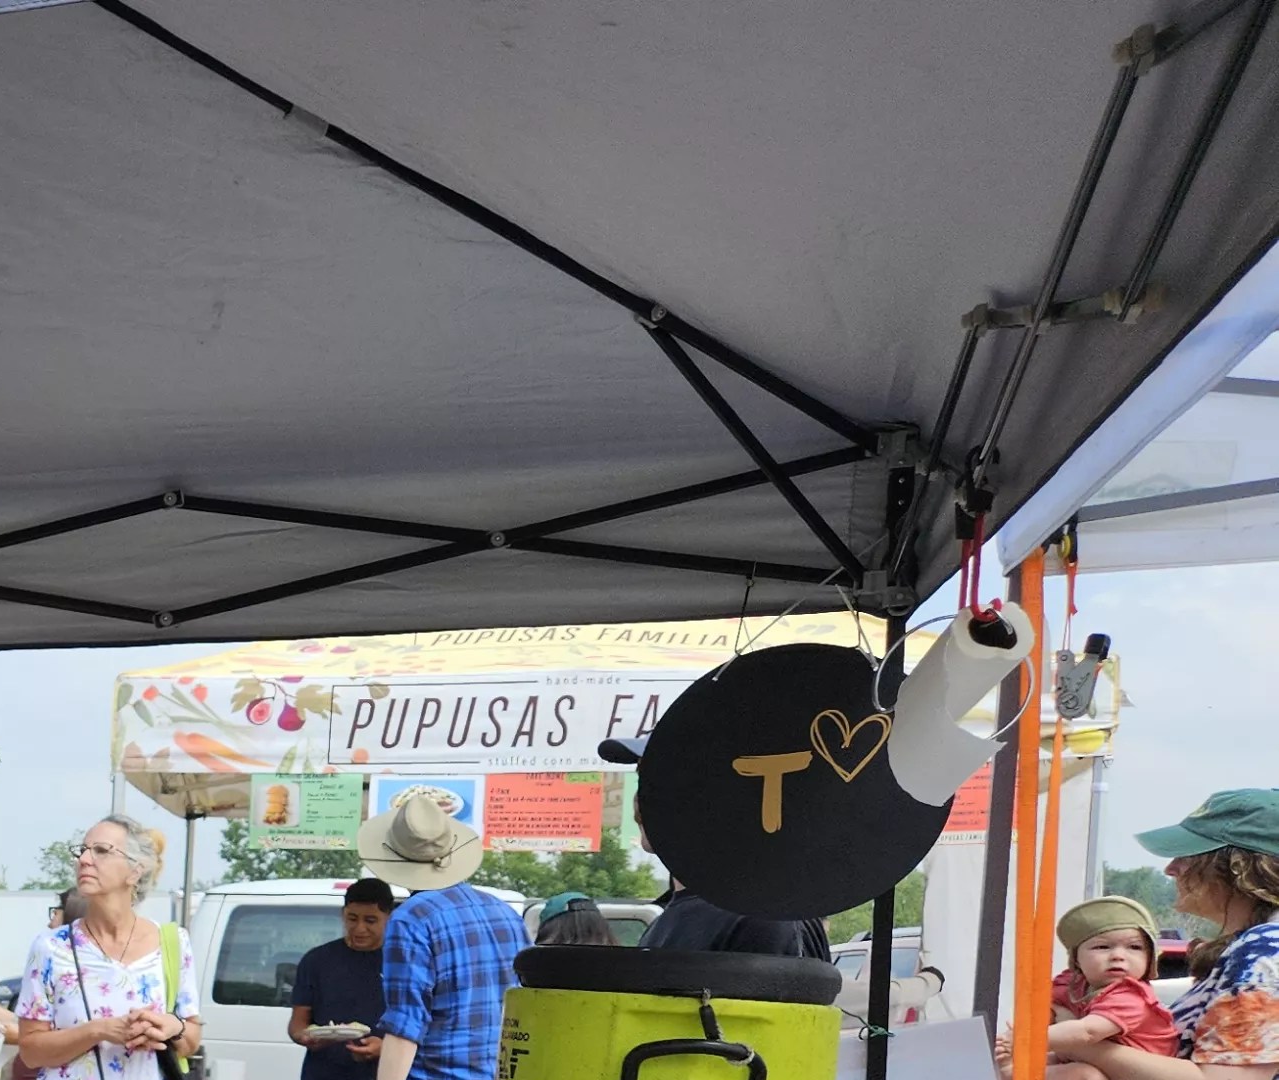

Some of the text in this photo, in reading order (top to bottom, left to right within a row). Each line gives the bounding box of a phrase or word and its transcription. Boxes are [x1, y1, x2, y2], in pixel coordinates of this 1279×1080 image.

[430, 626, 729, 647] PUPUSAS FAMILIA
[545, 674, 623, 686] hand-made
[346, 694, 576, 750] PUPUSAS
[487, 756, 537, 768] stuffed
[542, 756, 574, 768] corn
[731, 750, 814, 834] T
